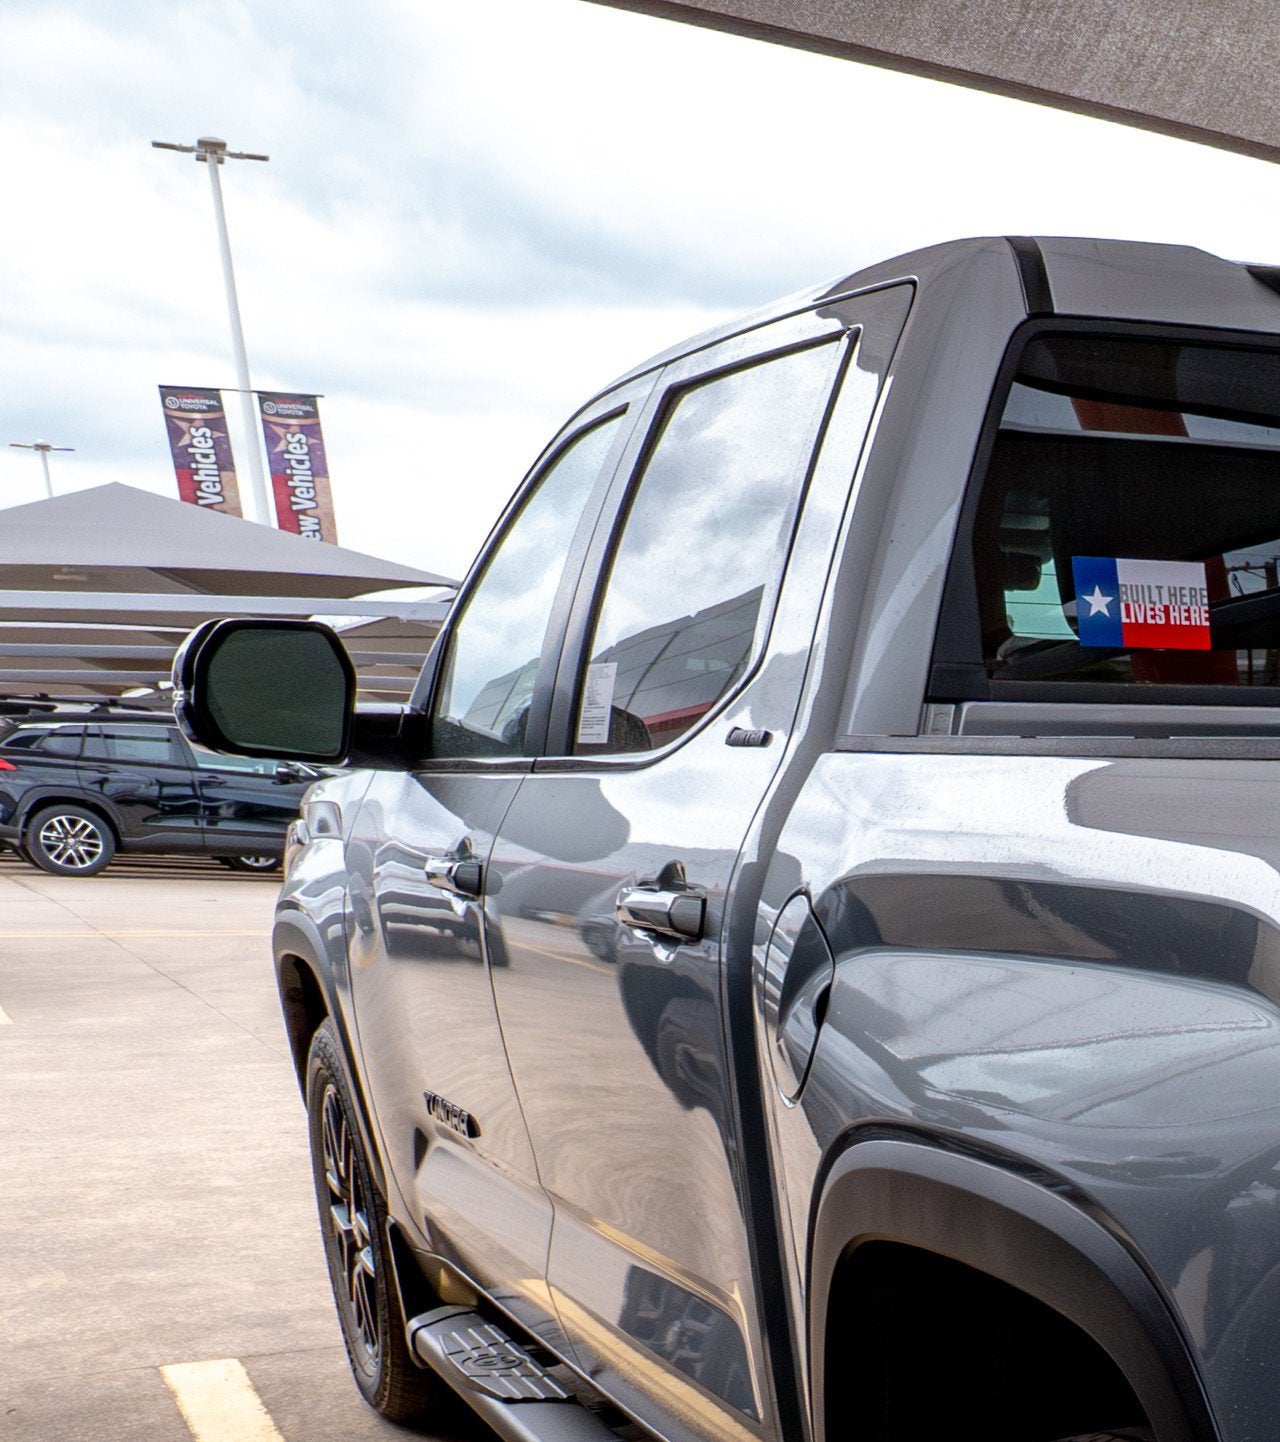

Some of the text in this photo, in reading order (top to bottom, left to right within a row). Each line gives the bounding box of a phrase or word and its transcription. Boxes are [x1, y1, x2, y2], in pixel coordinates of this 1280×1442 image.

[187, 426, 225, 506] Vehicles
[283, 431, 318, 511] Vehicles
[299, 515, 323, 541] ew
[1119, 584, 1208, 606] BUILT HERE
[1120, 602, 1210, 627] LIVES HERE
[423, 1089, 478, 1138] TUNDRA
